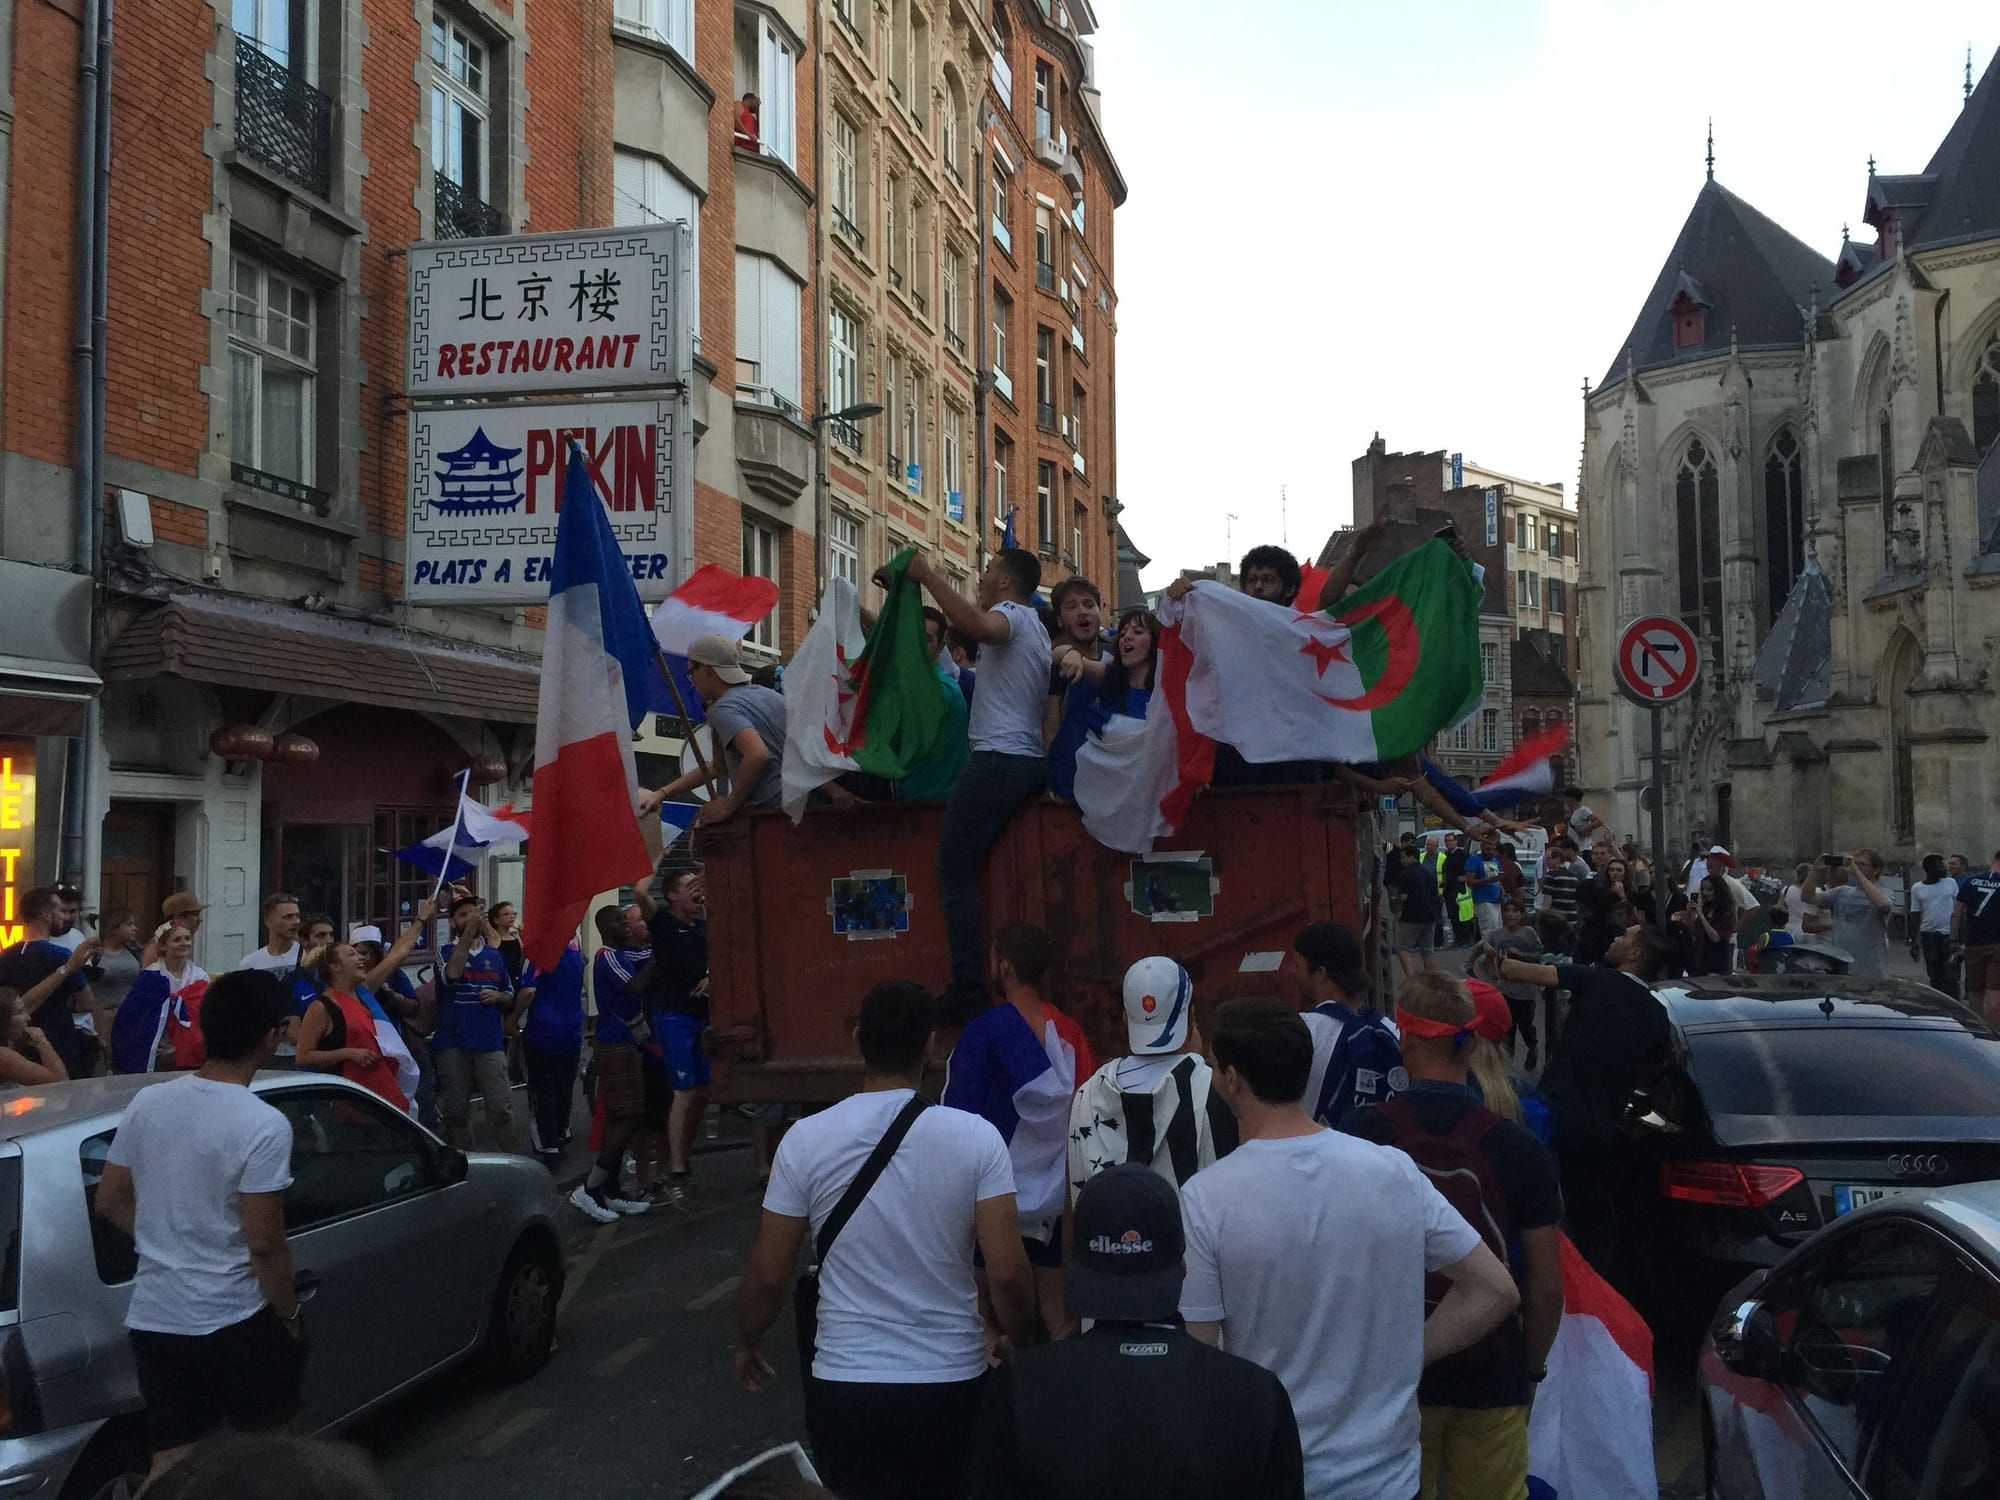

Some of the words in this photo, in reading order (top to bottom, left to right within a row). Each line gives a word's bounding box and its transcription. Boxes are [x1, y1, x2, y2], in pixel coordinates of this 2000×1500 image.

[458, 268, 622, 323] 北京楼
[437, 333, 640, 379] RESTAURANT
[1487, 491, 1497, 546] HOTEL
[413, 558, 488, 585] PLATS
[494, 558, 511, 584] A
[2, 757, 21, 830] LE
[1974, 886, 1997, 917] 7
[1779, 1210, 1808, 1222] A5
[1089, 1234, 1153, 1255] ellesse
